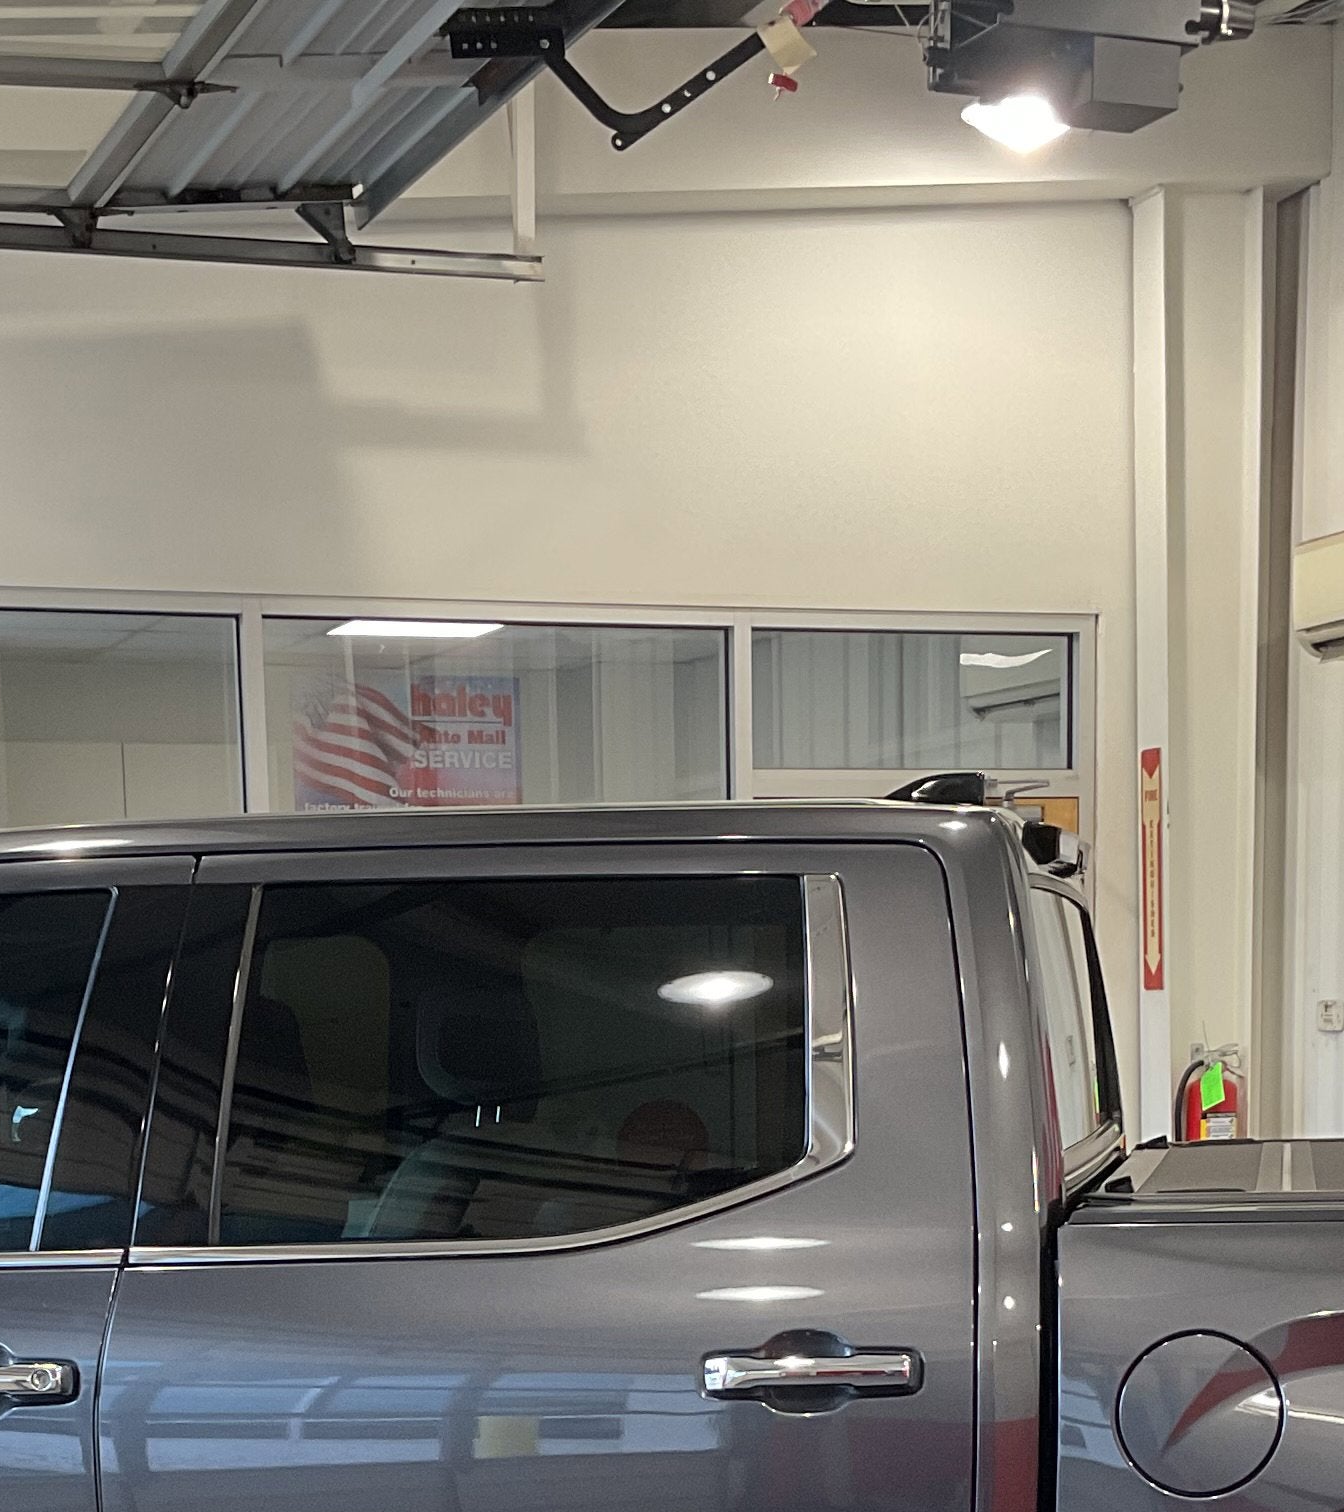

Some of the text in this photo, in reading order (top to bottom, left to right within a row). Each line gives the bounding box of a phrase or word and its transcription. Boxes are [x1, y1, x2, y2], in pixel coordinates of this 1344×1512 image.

[410, 682, 513, 727] haley
[419, 729, 506, 745] Auto Mall
[414, 750, 513, 769] SERVICE
[388, 786, 516, 798] Our technicians are
[1144, 789, 1158, 802] FIRE
